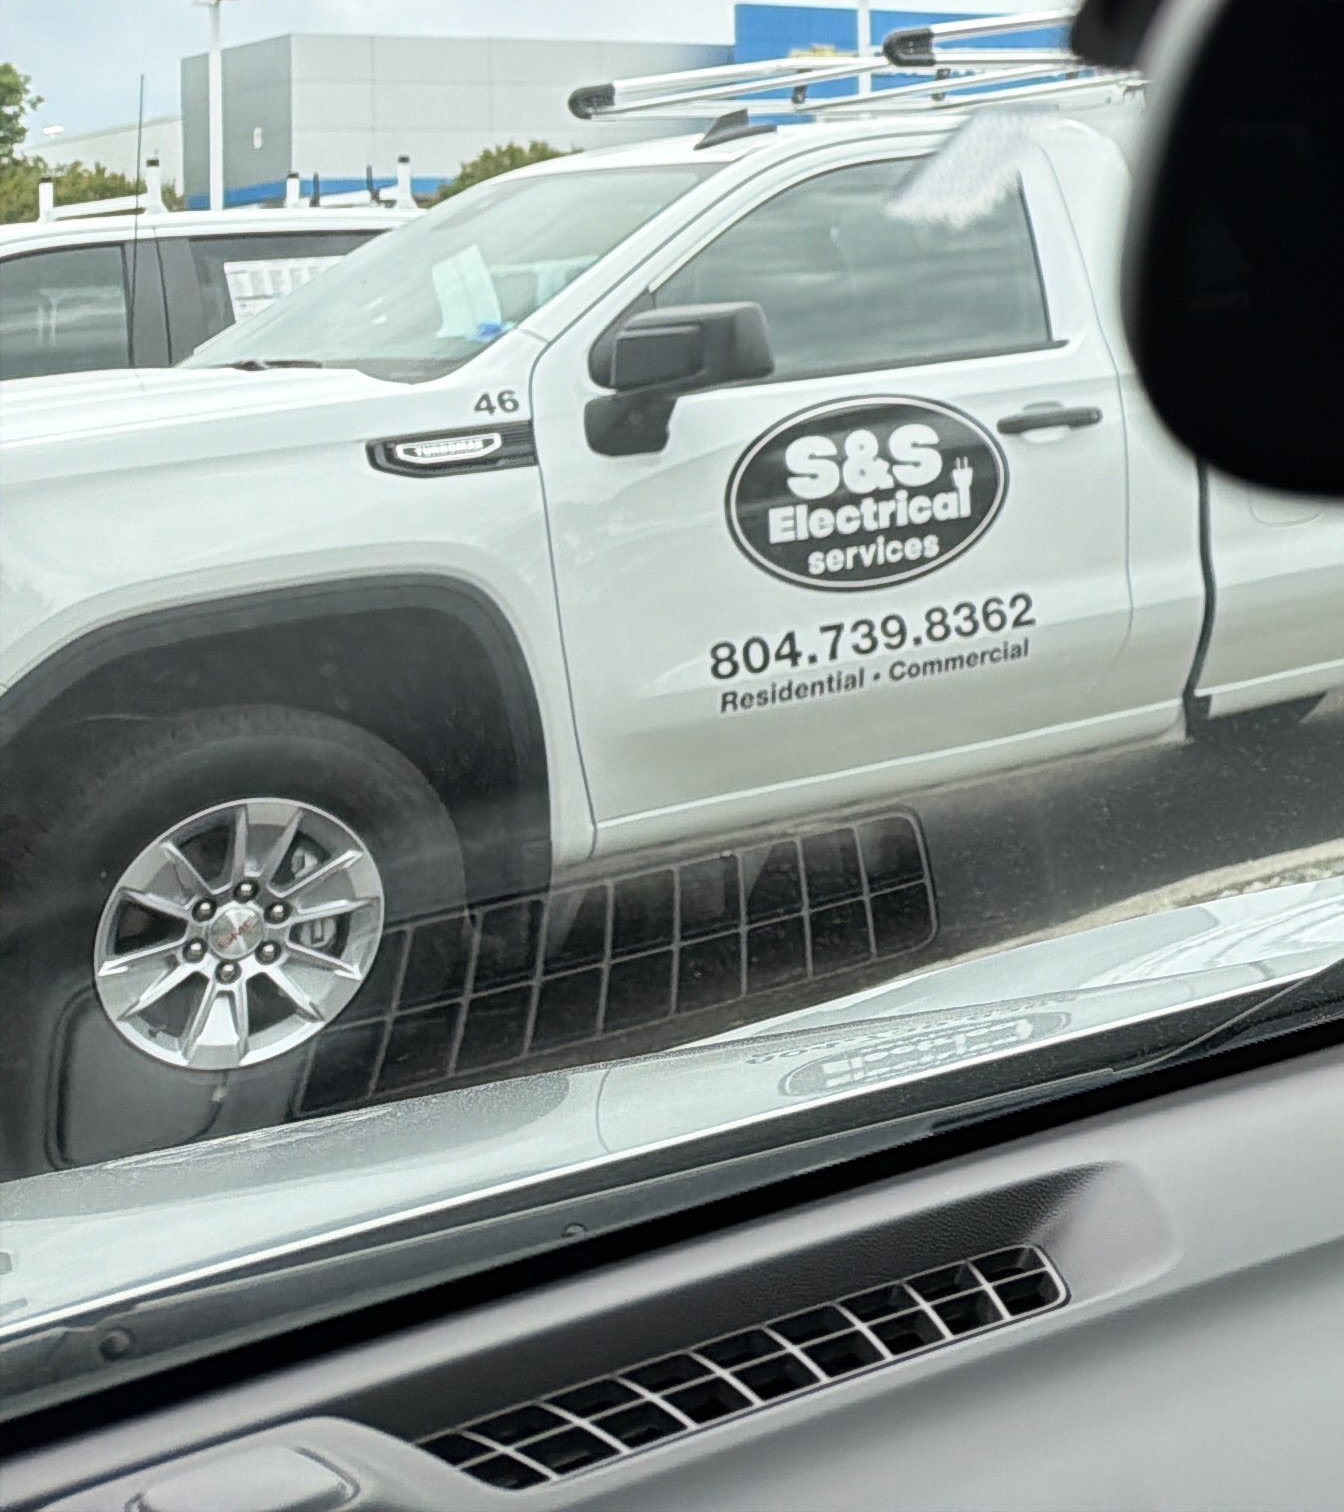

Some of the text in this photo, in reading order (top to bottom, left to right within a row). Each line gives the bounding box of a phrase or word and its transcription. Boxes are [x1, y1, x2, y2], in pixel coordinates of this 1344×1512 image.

[474, 390, 519, 415] 46
[785, 424, 942, 500] S&S
[768, 485, 972, 544] Electrical
[808, 534, 940, 575] services
[710, 593, 1037, 680] 804.739.8362
[719, 638, 1030, 713] Residential Commercial
